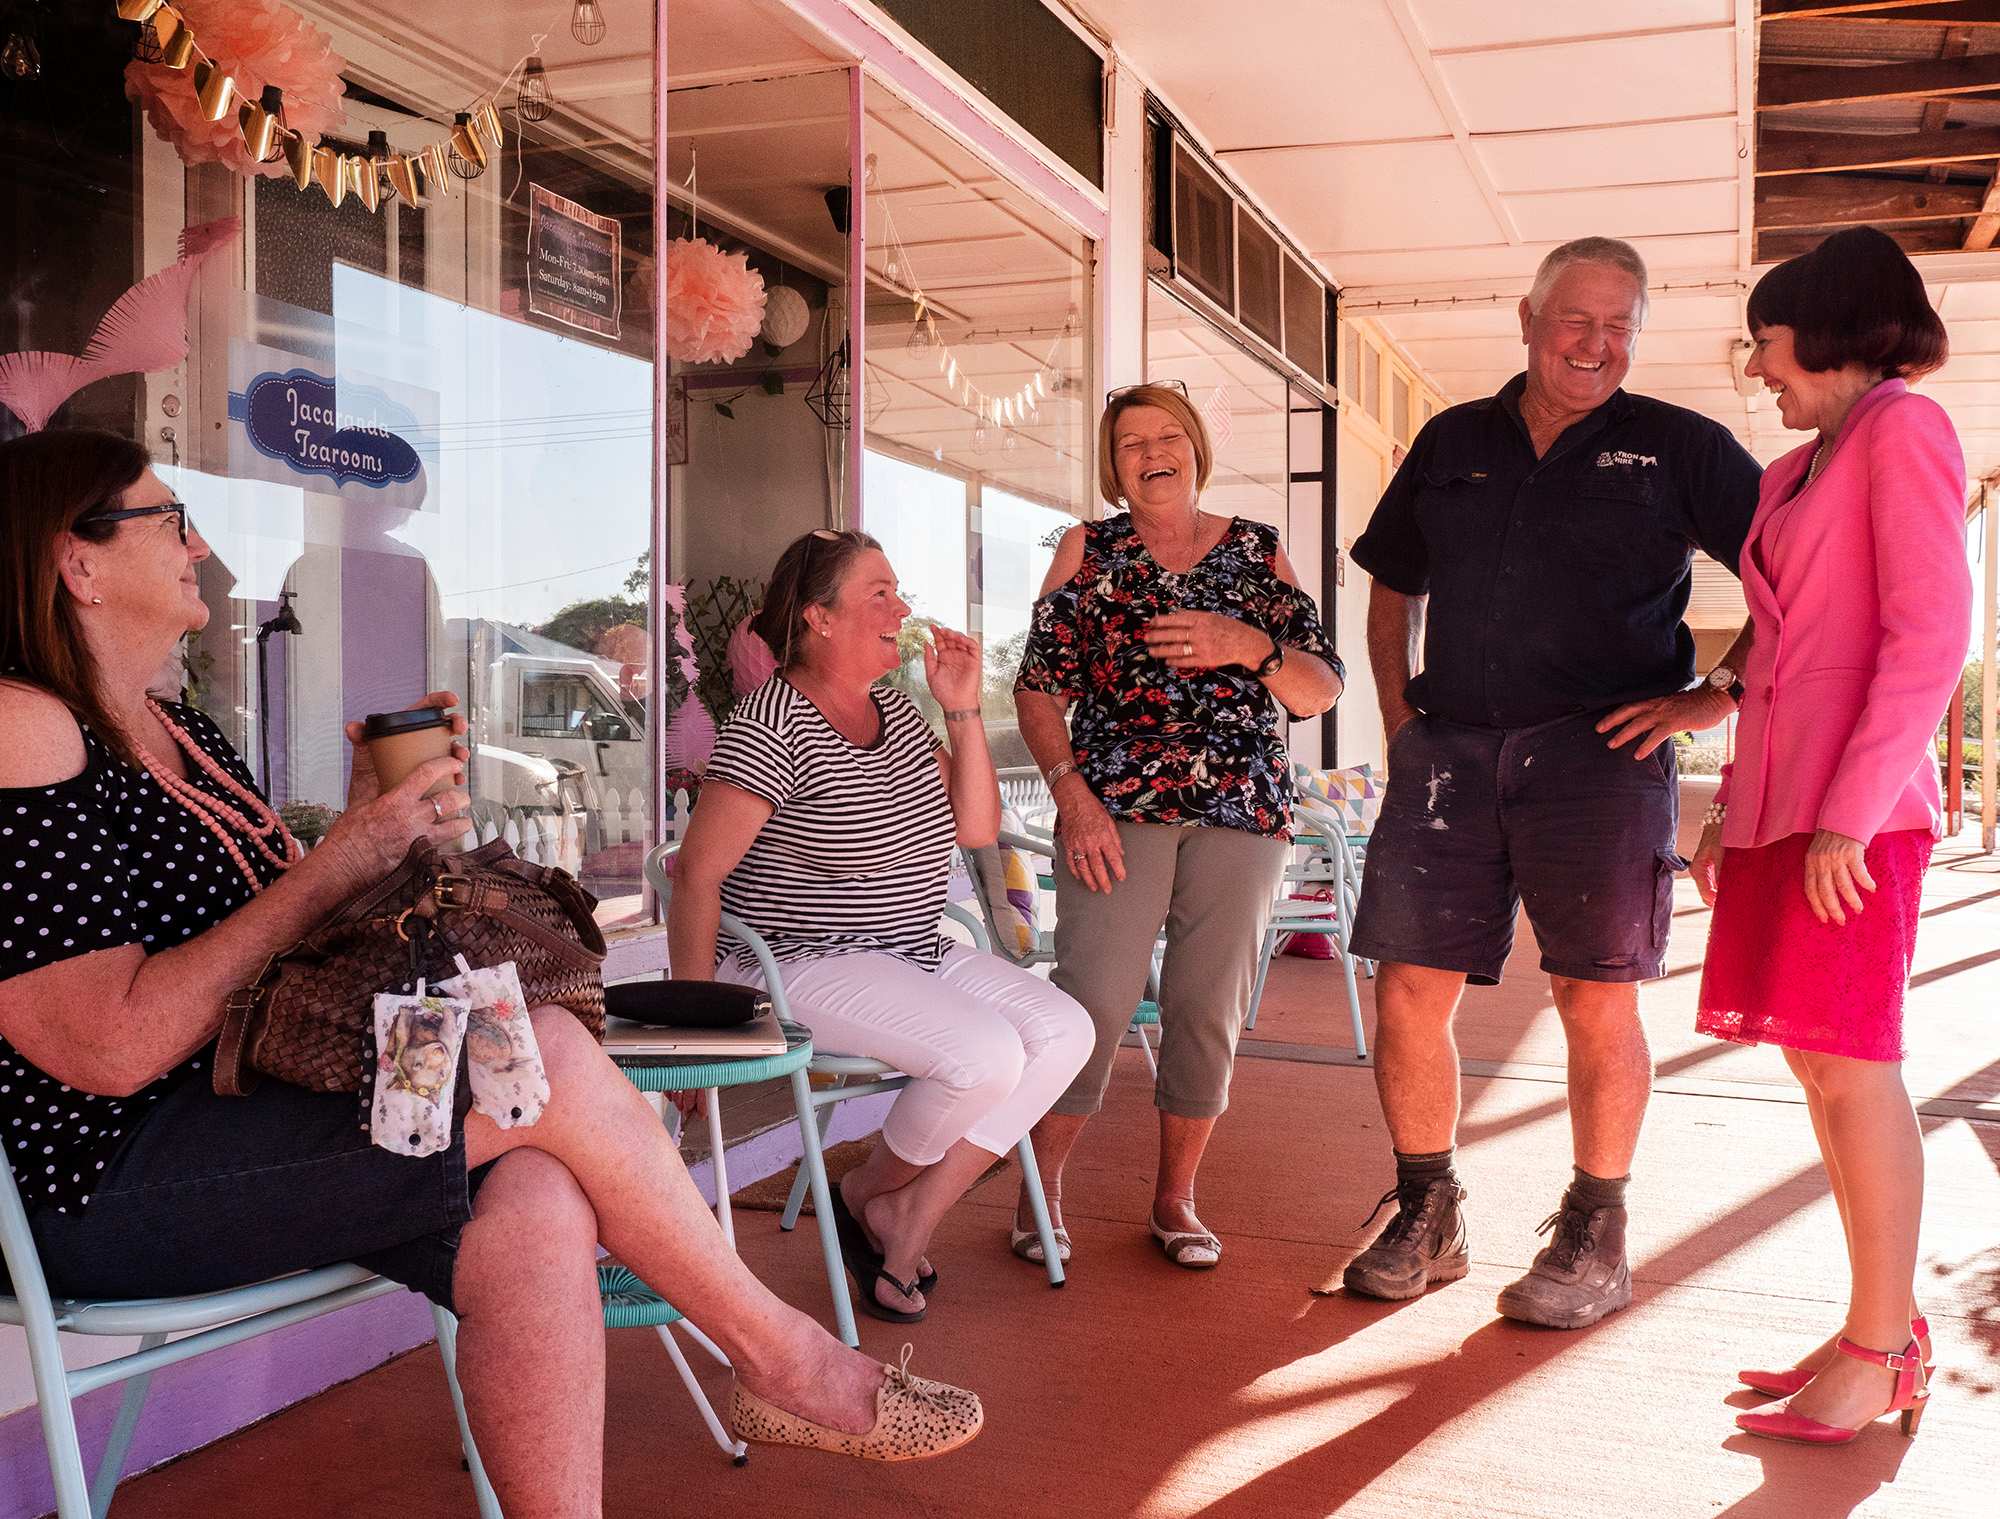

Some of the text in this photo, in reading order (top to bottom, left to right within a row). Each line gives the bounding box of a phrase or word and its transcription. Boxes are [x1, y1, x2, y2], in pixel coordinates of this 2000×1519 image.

[539, 248, 571, 270] Mon-Fri:
[539, 269, 571, 293] Saturday:
[286, 388, 390, 438] Jacaranda
[295, 429, 382, 473] Tearooms
